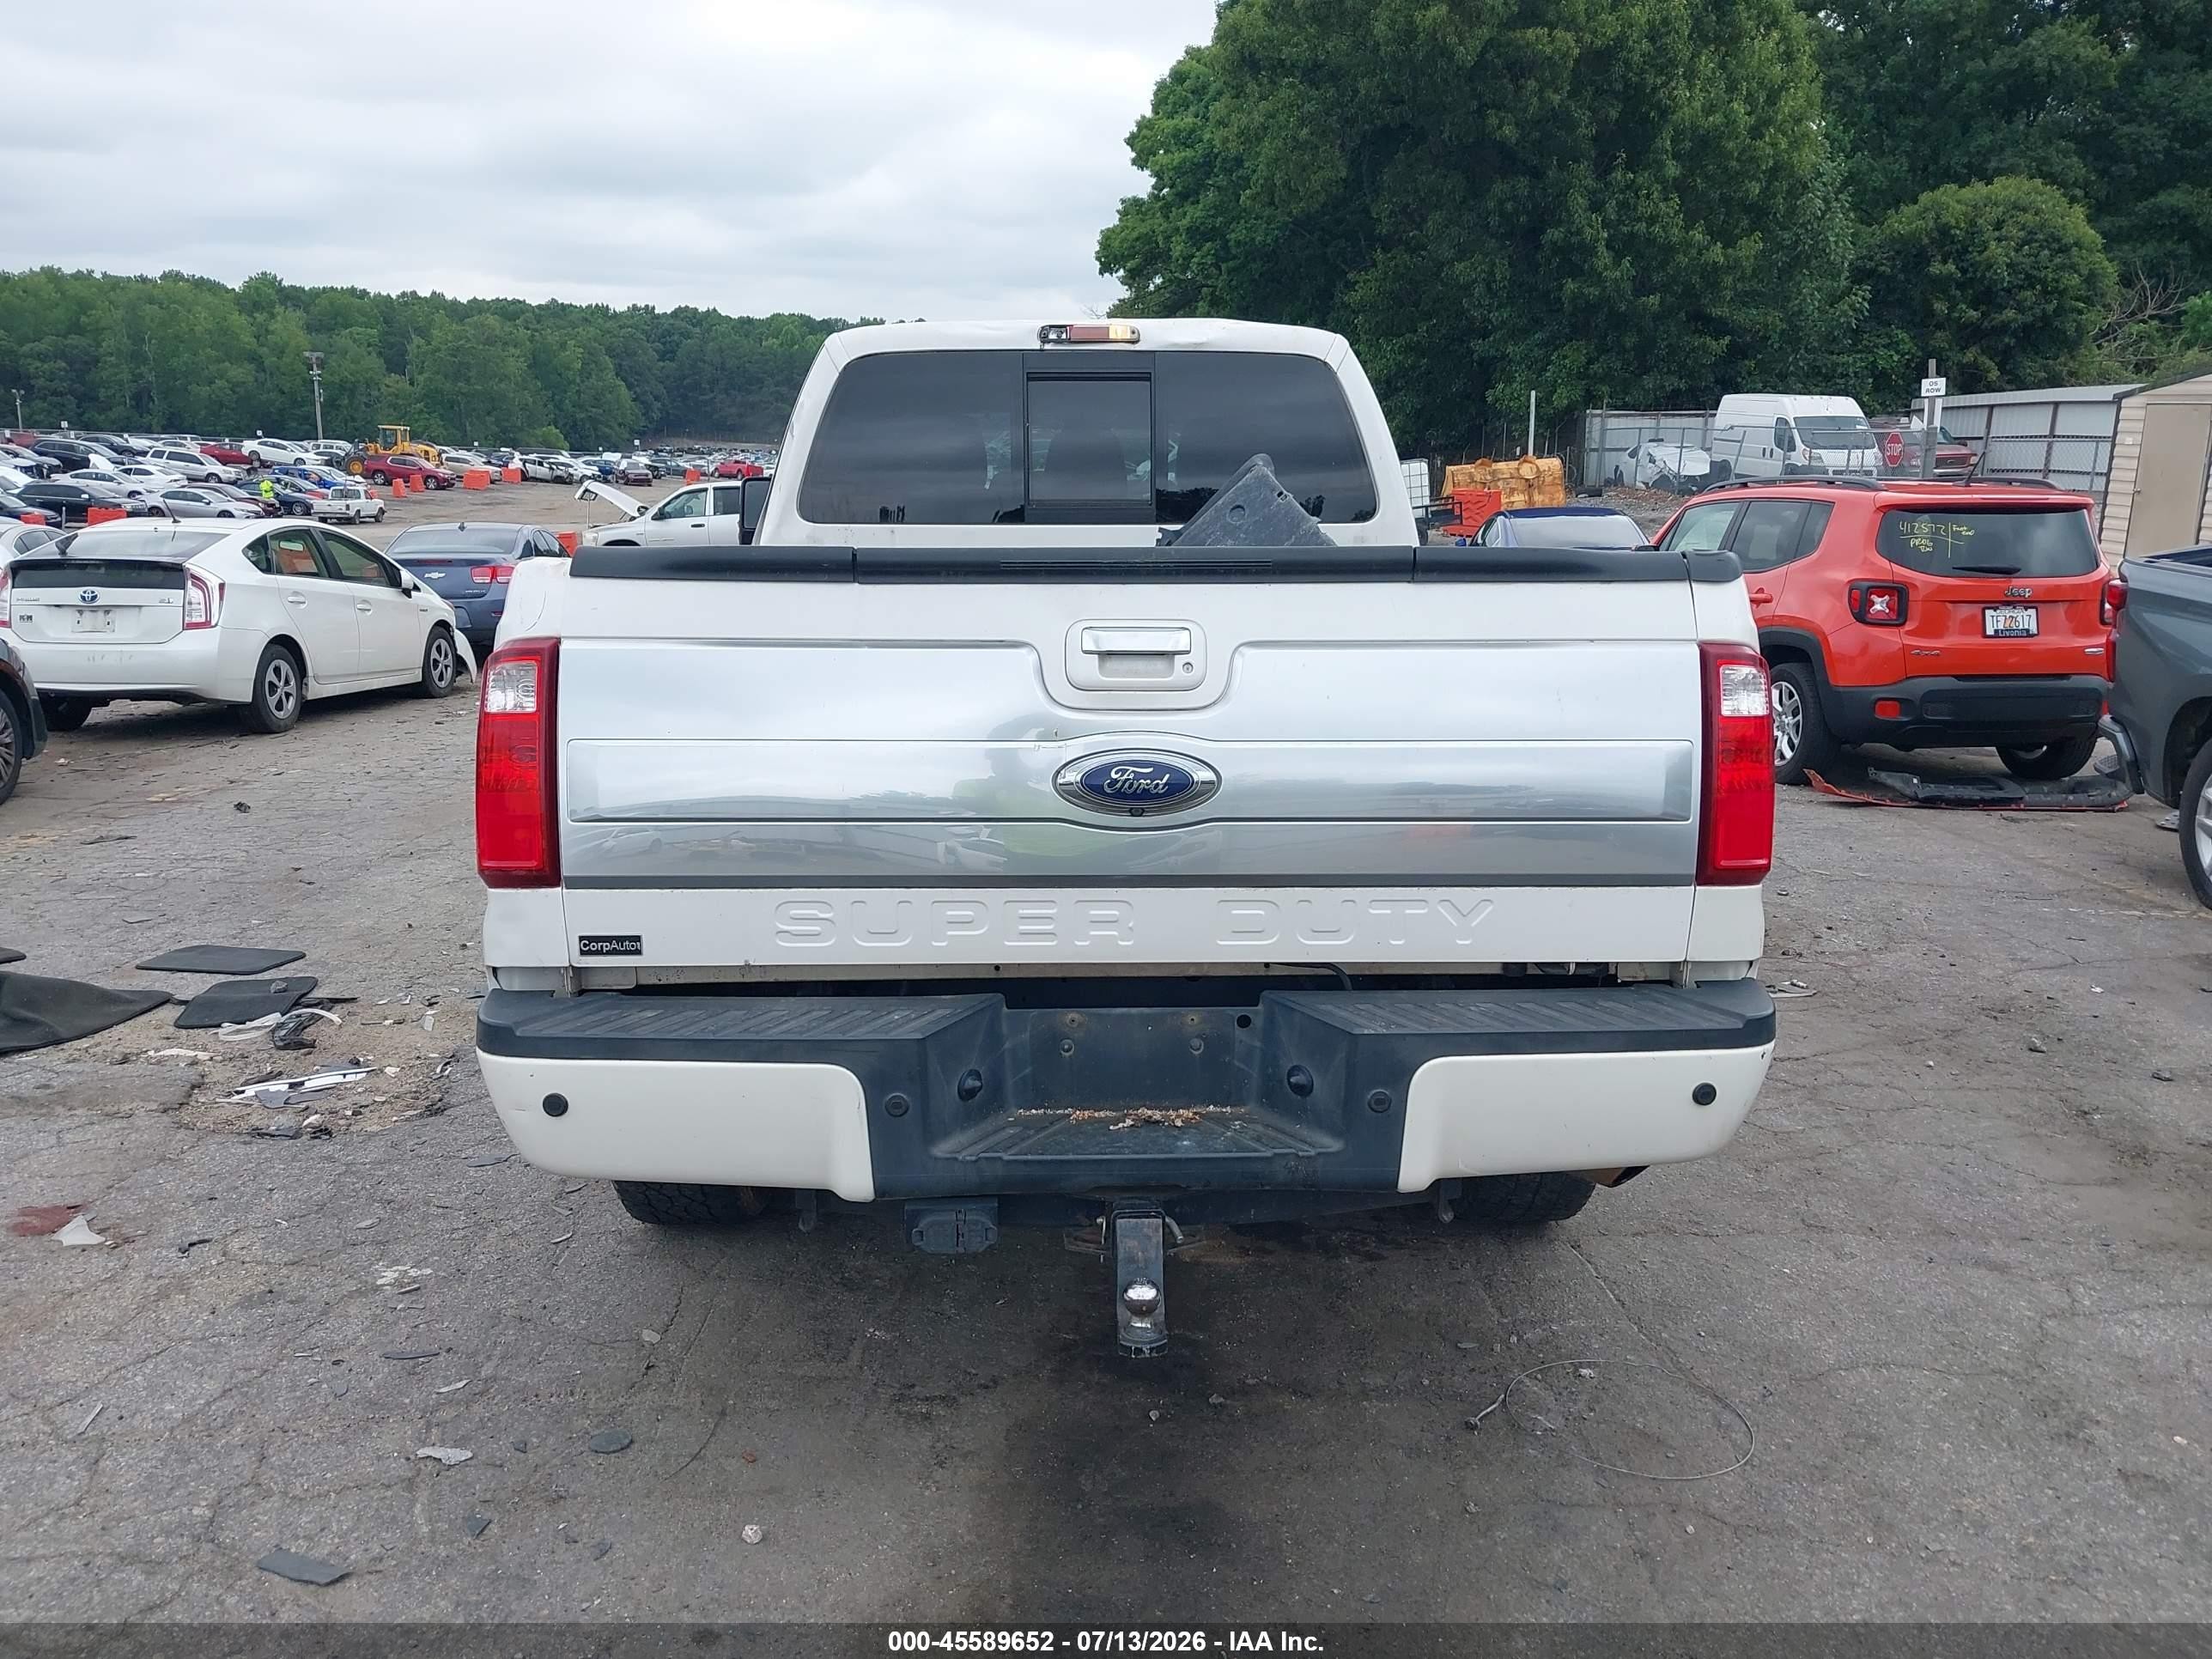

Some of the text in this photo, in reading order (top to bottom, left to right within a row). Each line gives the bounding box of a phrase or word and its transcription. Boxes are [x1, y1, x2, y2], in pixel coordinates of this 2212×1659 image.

[1887, 443, 1902, 455] STOP
[1899, 520, 1947, 536] 412572
[2004, 586, 2033, 599] Jeep
[1990, 614, 2032, 629] TFZ2617
[1103, 766, 1170, 793] Ford
[775, 899, 1494, 946] SUPER DUTY
